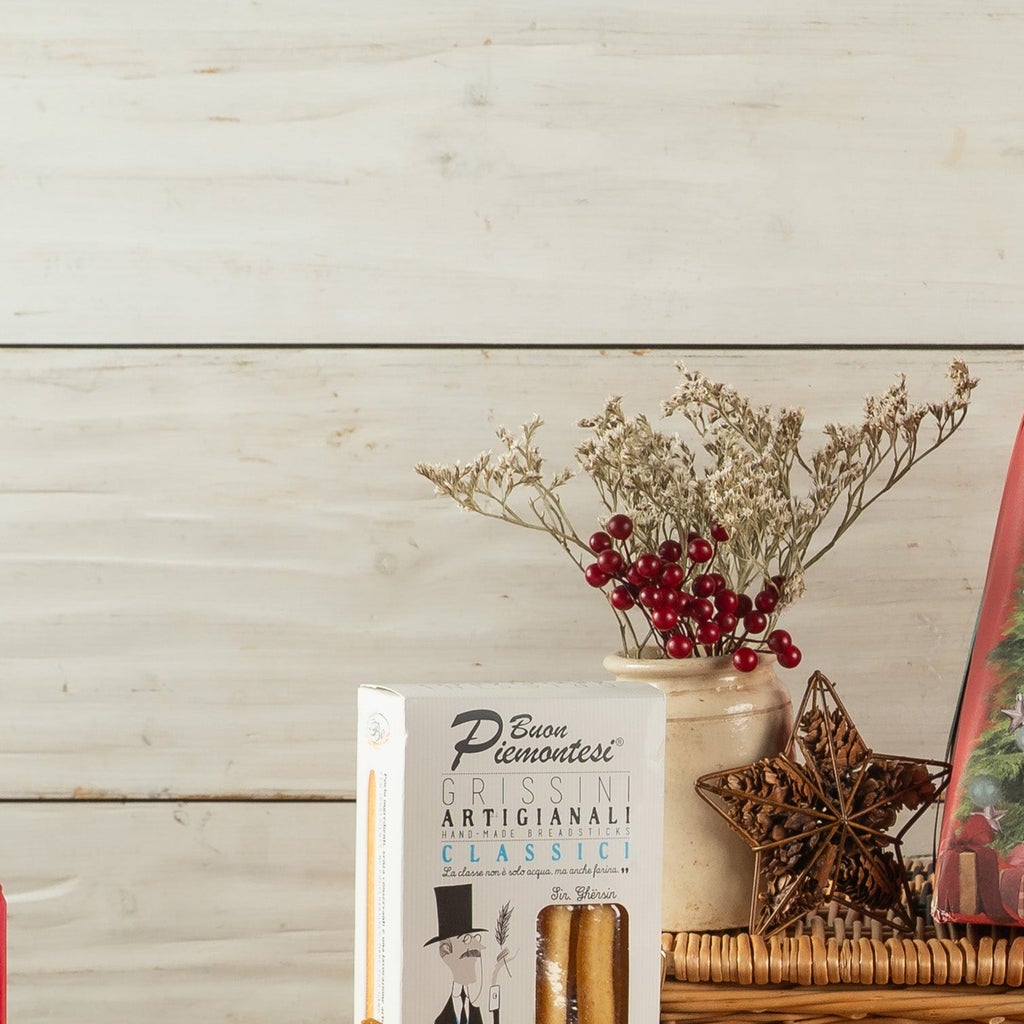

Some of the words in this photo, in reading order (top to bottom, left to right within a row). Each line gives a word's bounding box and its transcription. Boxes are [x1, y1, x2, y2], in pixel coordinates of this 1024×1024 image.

[509, 713, 568, 739] Buon
[442, 776, 630, 806] GRISSINI
[442, 806, 631, 828] ARTIGIANALI
[442, 829, 515, 839] HAND-MADE
[528, 827, 631, 838] BREADSTICKS
[442, 841, 630, 863] CLASSICI
[442, 866, 456, 878] La
[458, 867, 484, 877] classe
[485, 869, 500, 877] non
[509, 865, 525, 876] solo
[554, 868, 567, 876] ma
[569, 864, 592, 875] anche
